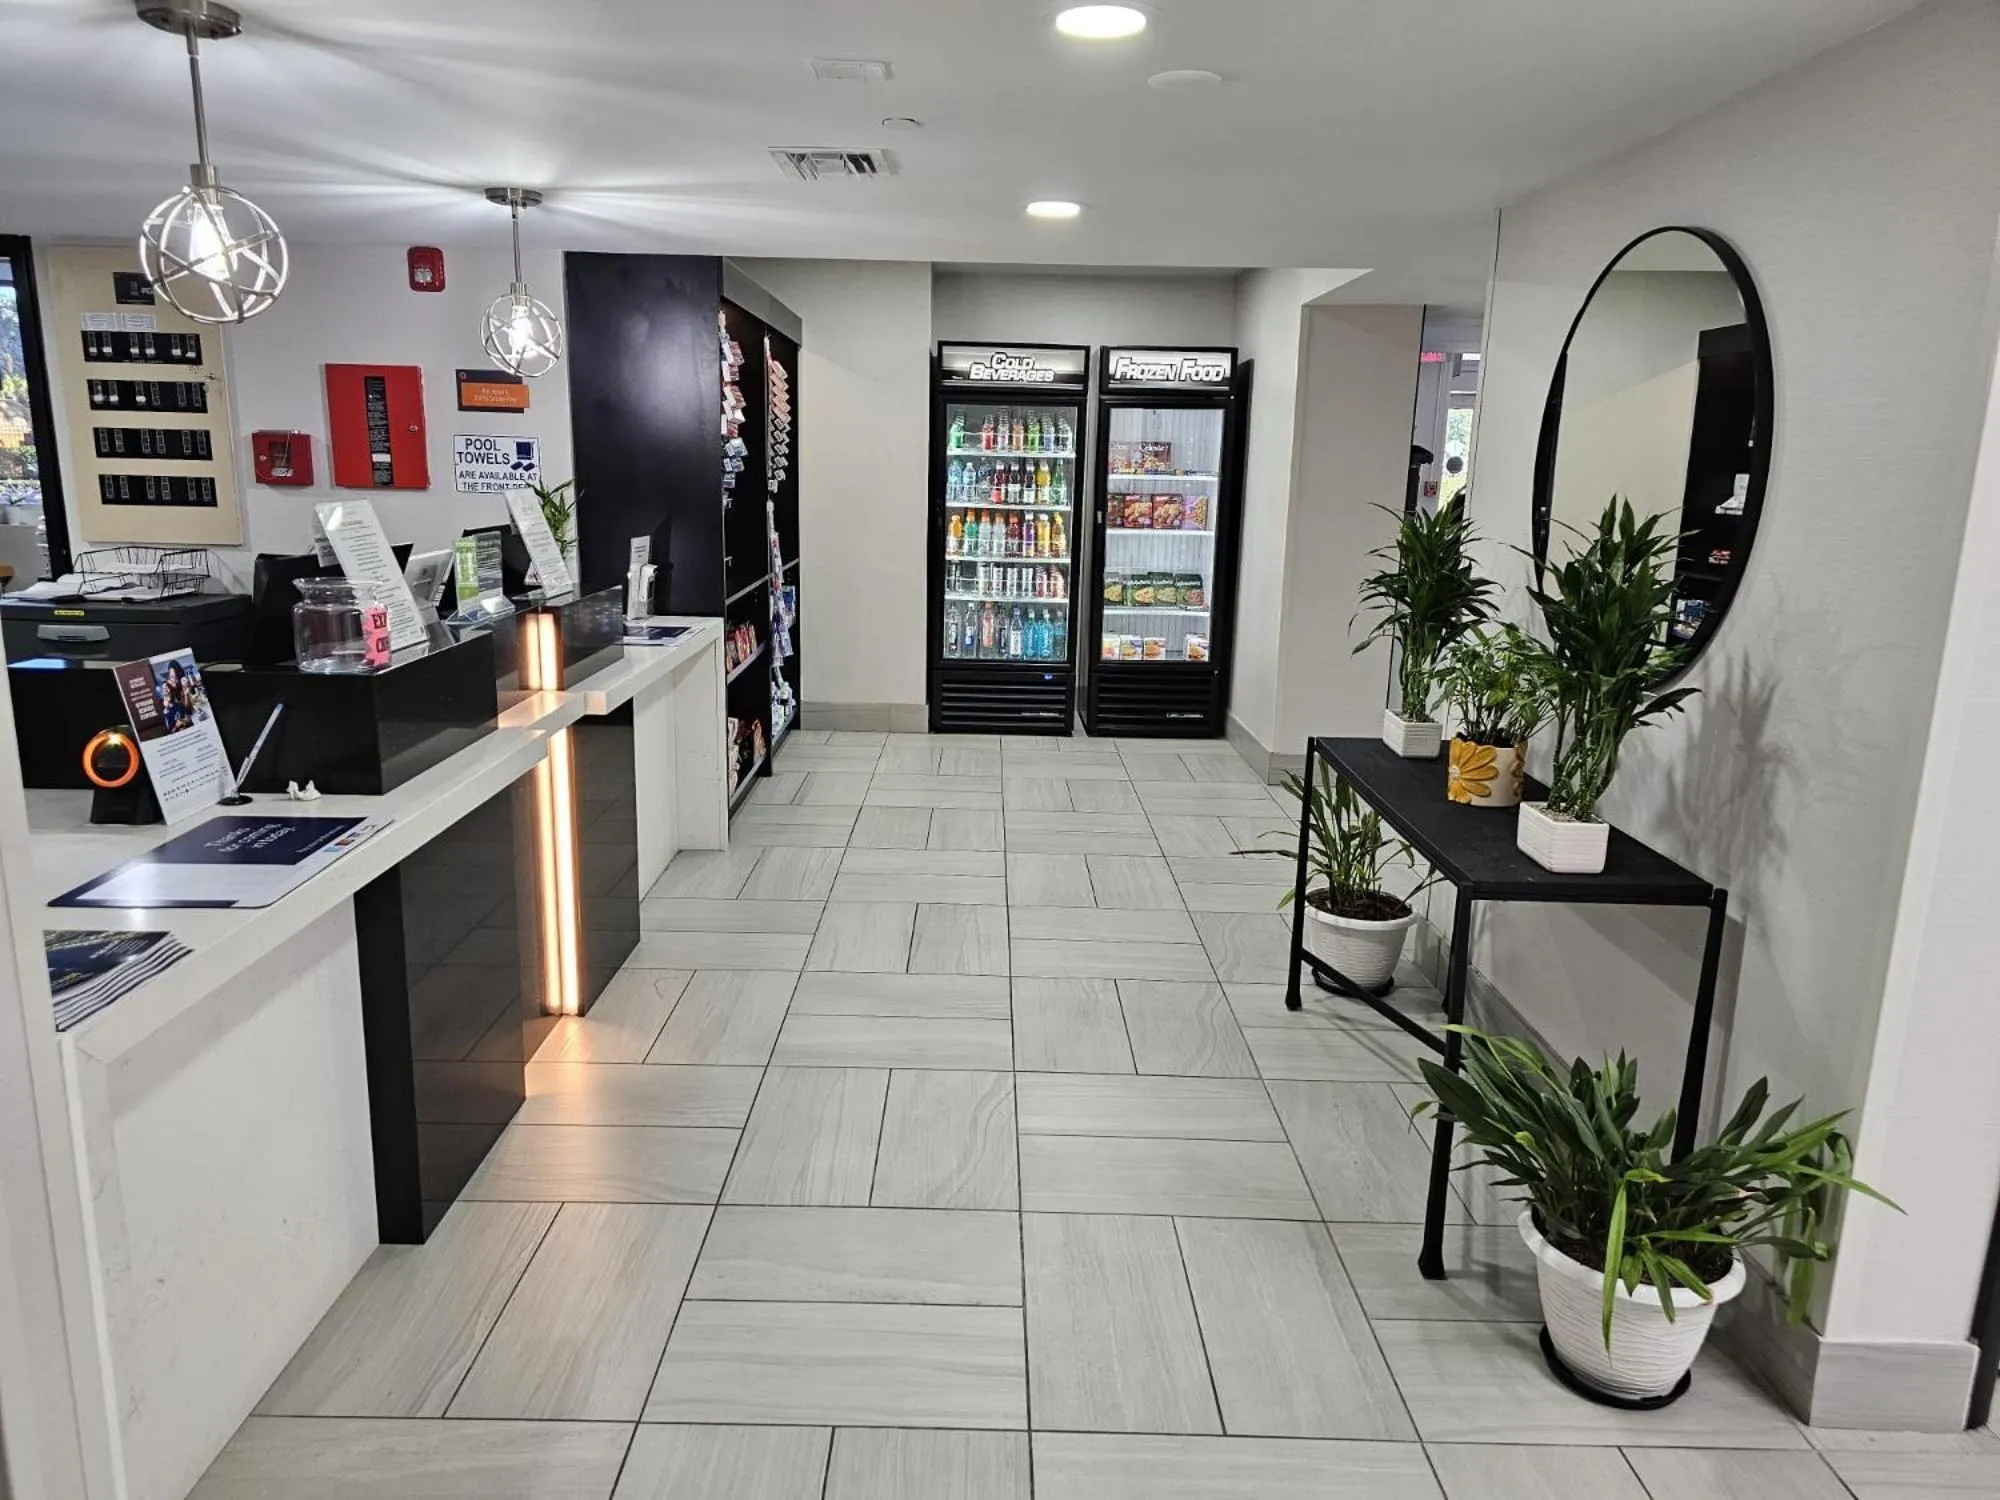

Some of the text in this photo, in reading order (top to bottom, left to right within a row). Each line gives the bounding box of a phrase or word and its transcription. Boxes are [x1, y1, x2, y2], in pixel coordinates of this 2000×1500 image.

[991, 353, 1035, 370] COLD
[970, 363, 1055, 382] BEVERAGES
[1115, 357, 1225, 382] FROZEN FOOD
[465, 438, 501, 451] POOL
[456, 451, 510, 465] TOWELS
[459, 470, 537, 481] ARE AVAILABLE AT
[463, 482, 479, 491] THE
[481, 482, 510, 491] FRONT
